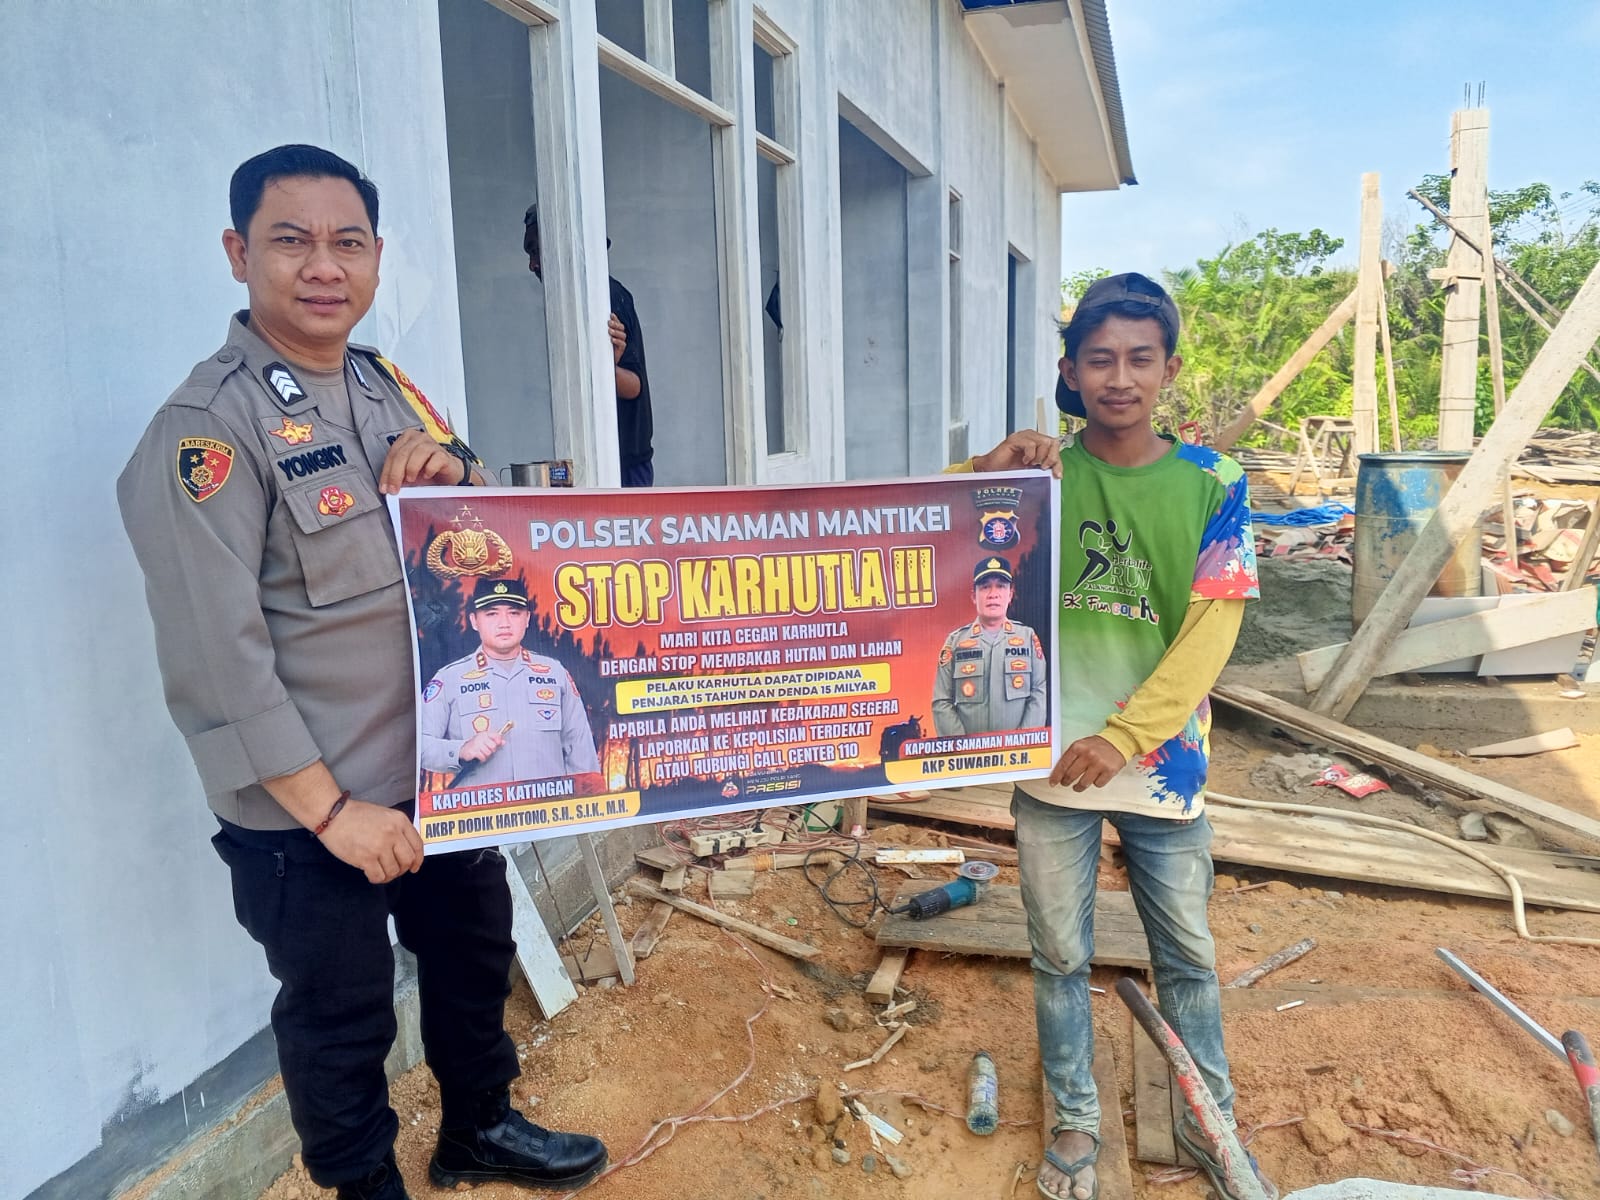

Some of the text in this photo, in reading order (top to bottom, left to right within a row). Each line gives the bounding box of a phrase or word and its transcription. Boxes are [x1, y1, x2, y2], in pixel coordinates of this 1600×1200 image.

[278, 445, 347, 481] YONGKY
[530, 505, 951, 550] POLSEK SANAMAN MANTIKEI
[555, 546, 936, 629] STOP KARHUTLA !!!
[1110, 566, 1152, 591] RUN
[1087, 595, 1111, 613] Fun
[660, 622, 848, 649] MARI KITA CEGAH KARHUTLA
[601, 640, 902, 676] DENGAN STOP MEMBAKAR HUTAN DAN LAHAN
[1005, 648, 1030, 657] POLRI
[460, 681, 490, 694] DODIK
[529, 676, 557, 685] POLRI
[647, 669, 862, 694] PELAKU KARHUTLA DAPAT DIPIDANA
[631, 681, 876, 709] PENJARA 15 TAHUN DAN DENDA 15 MILYAR
[609, 699, 899, 739] APABILA ANDA MELIHAT KEBAKARAN SEGERA
[639, 721, 873, 760] LAPORKAN KE KEPOLISIAN TERDEKAT
[905, 731, 1049, 756] KAPOLSEK SANAMAN MANTIKEI
[655, 762, 690, 780] ATAU
[693, 753, 750, 776] HUBUNGI
[753, 748, 786, 768] CALL
[788, 744, 834, 764] CENTER
[838, 742, 859, 760] 110
[922, 752, 1032, 774] AKP SUWARDI, S.H.
[432, 779, 574, 811] KAPOLRES KATINGAN
[746, 780, 801, 794] PRESISI
[425, 820, 455, 839] AKBP
[458, 816, 494, 836] DODIK
[496, 810, 551, 830] HARTONO,
[606, 799, 629, 815] M.H.
